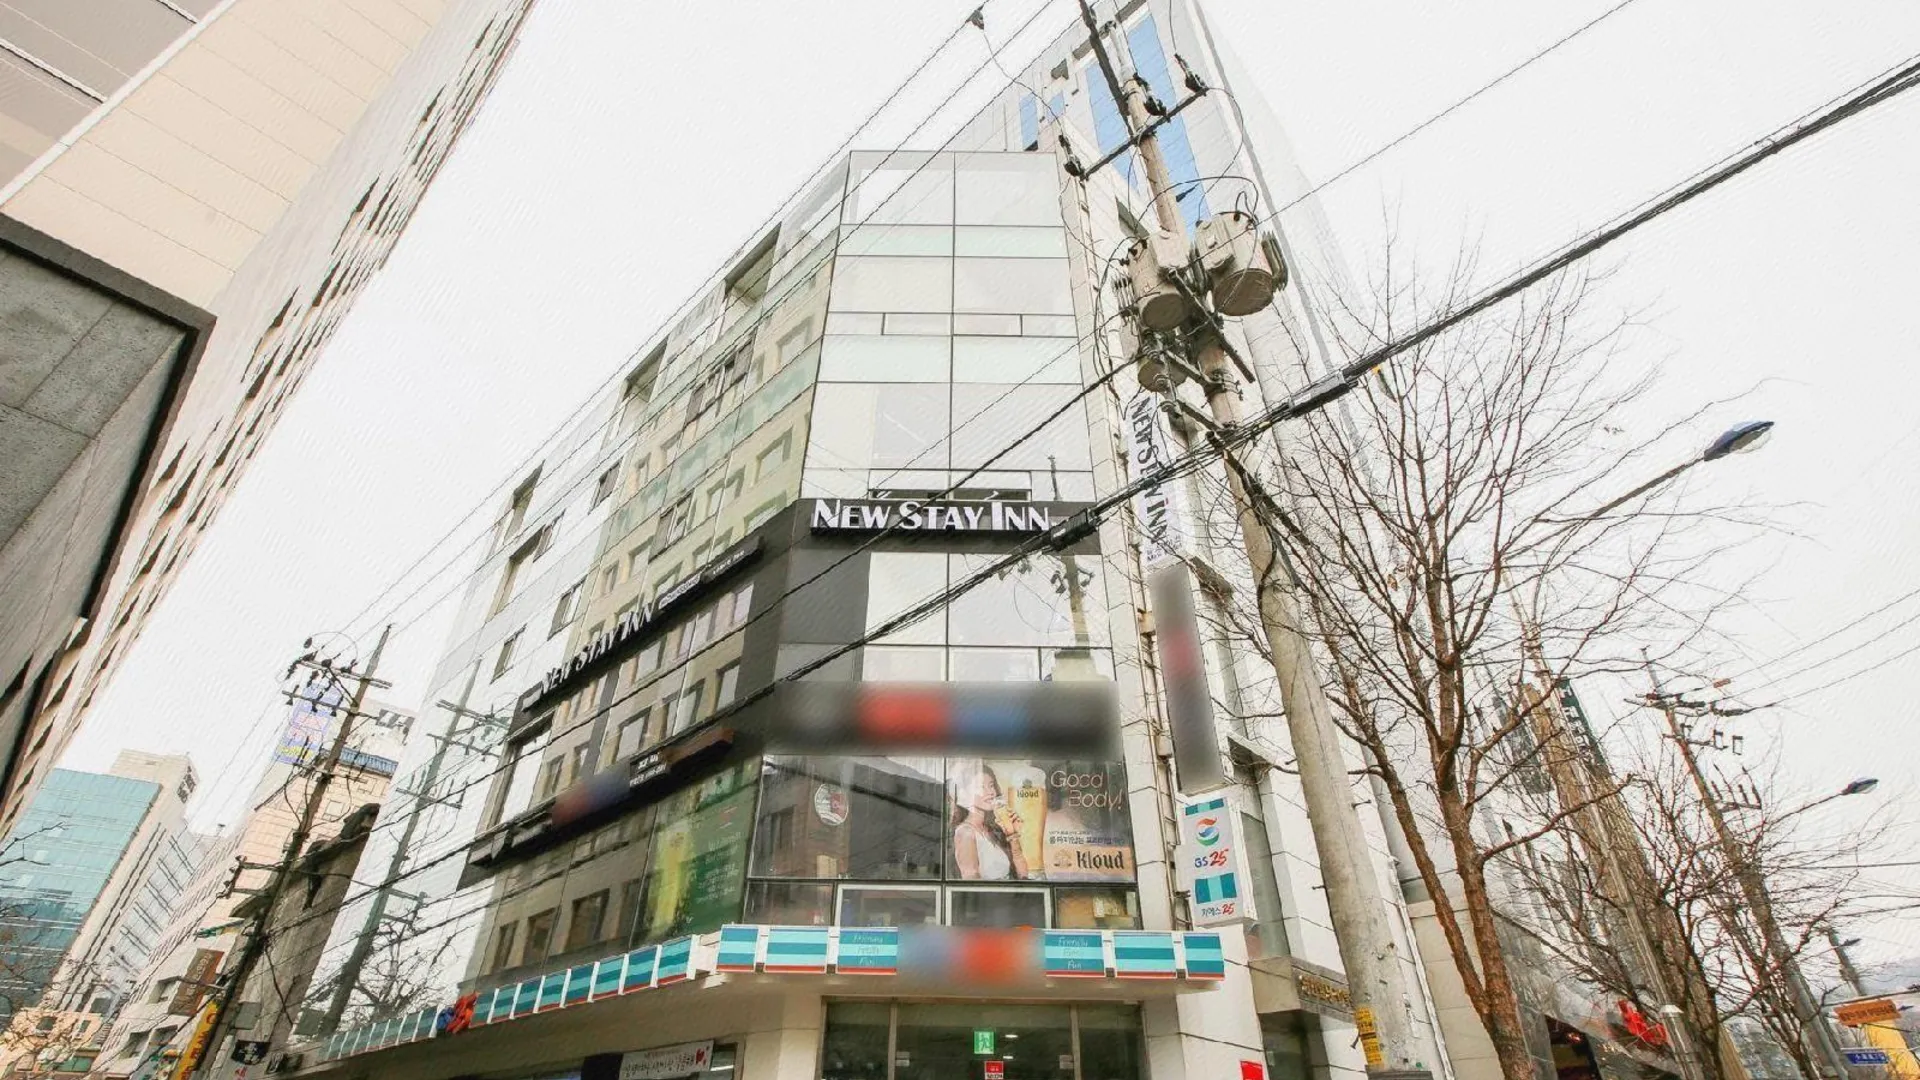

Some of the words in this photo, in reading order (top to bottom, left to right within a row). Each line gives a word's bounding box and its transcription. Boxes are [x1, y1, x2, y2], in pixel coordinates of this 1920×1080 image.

[811, 499, 891, 529] NEW
[899, 501, 984, 531] STAY
[991, 501, 1050, 531] INN
[540, 661, 573, 694] NEW
[575, 624, 620, 671] STAY
[1076, 850, 1124, 869] Kloud
